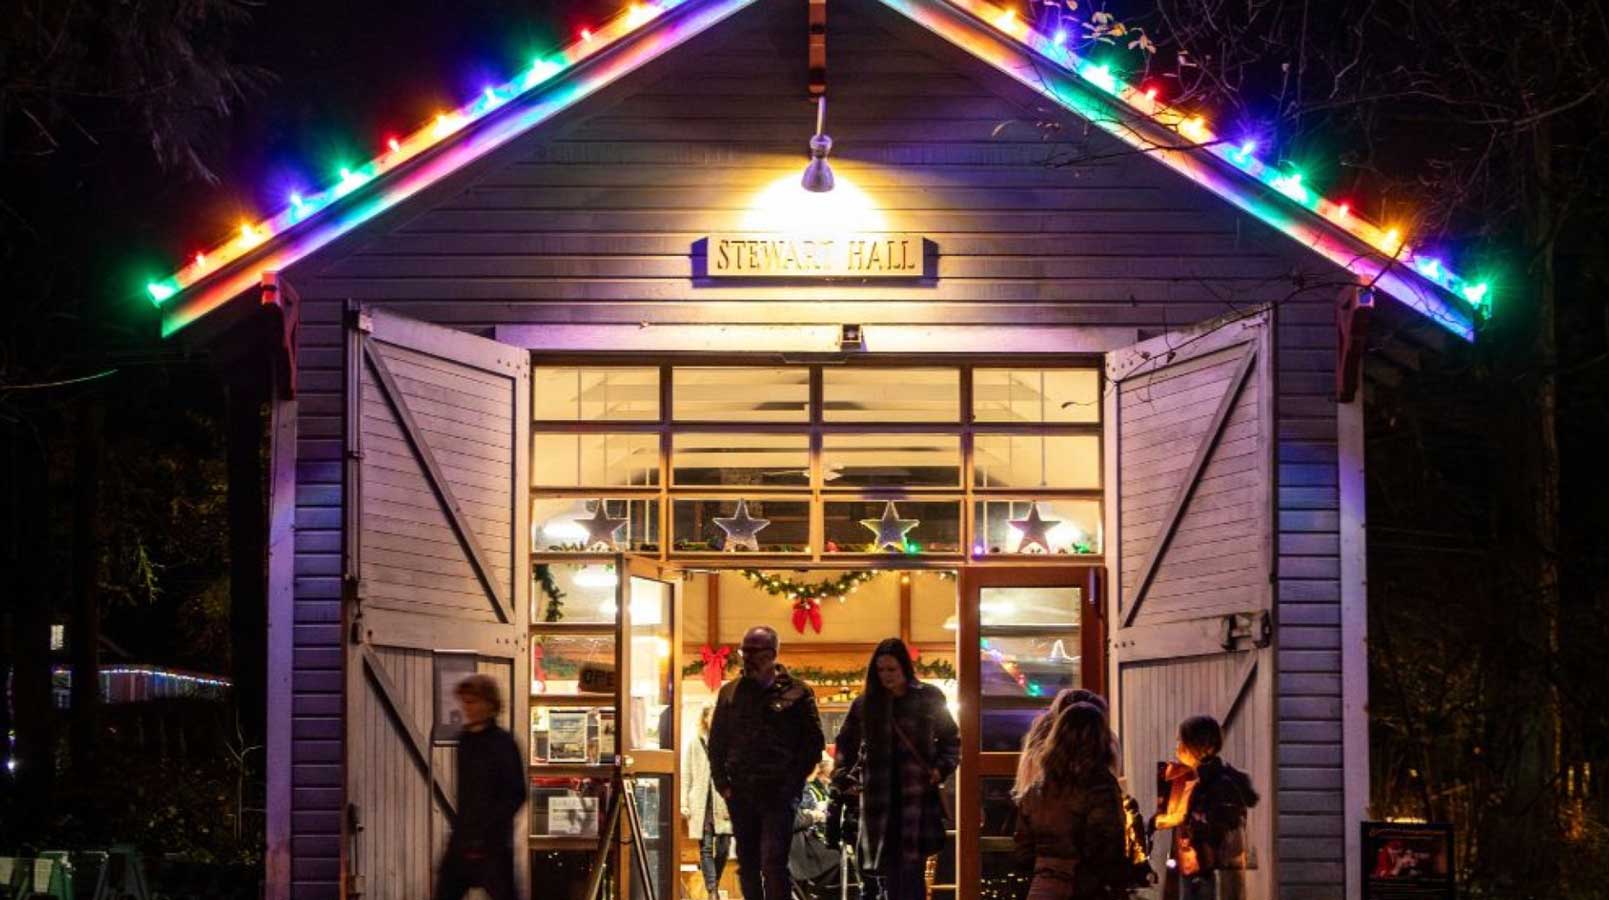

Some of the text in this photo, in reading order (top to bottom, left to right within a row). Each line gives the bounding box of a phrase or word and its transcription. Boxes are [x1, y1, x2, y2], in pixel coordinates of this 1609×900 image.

[717, 239, 916, 270] STEWART HALL
[583, 669, 616, 686] OPE
